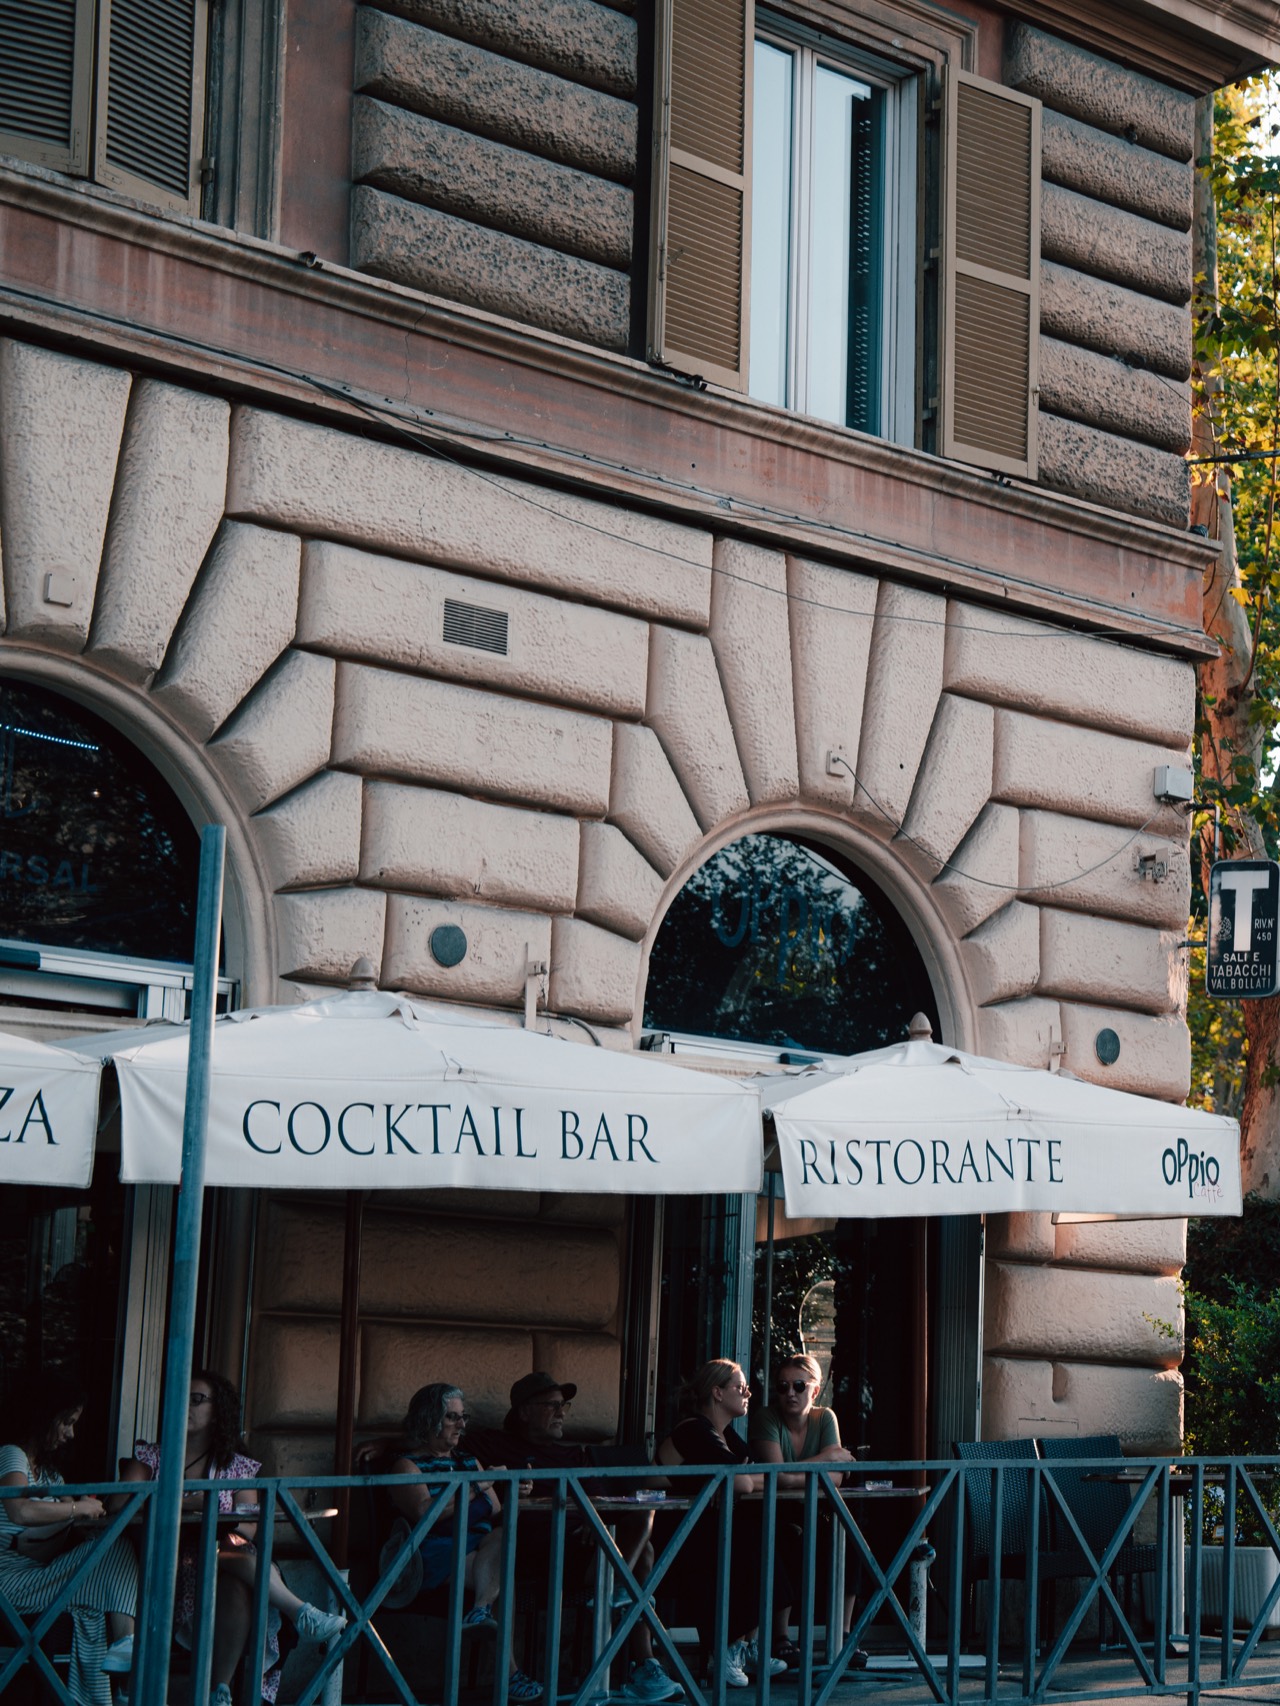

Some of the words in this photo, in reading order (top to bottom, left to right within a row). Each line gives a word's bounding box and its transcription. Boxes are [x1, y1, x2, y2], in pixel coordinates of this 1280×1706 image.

[1220, 870, 1270, 952] T
[1211, 964, 1271, 977] TABACCHI
[1223, 953, 1247, 963] SALI
[1253, 952, 1260, 962] E
[242, 1099, 538, 1159] COCKTAIL
[558, 1109, 661, 1164] BAR
[798, 1137, 1064, 1186] RISTORANTE
